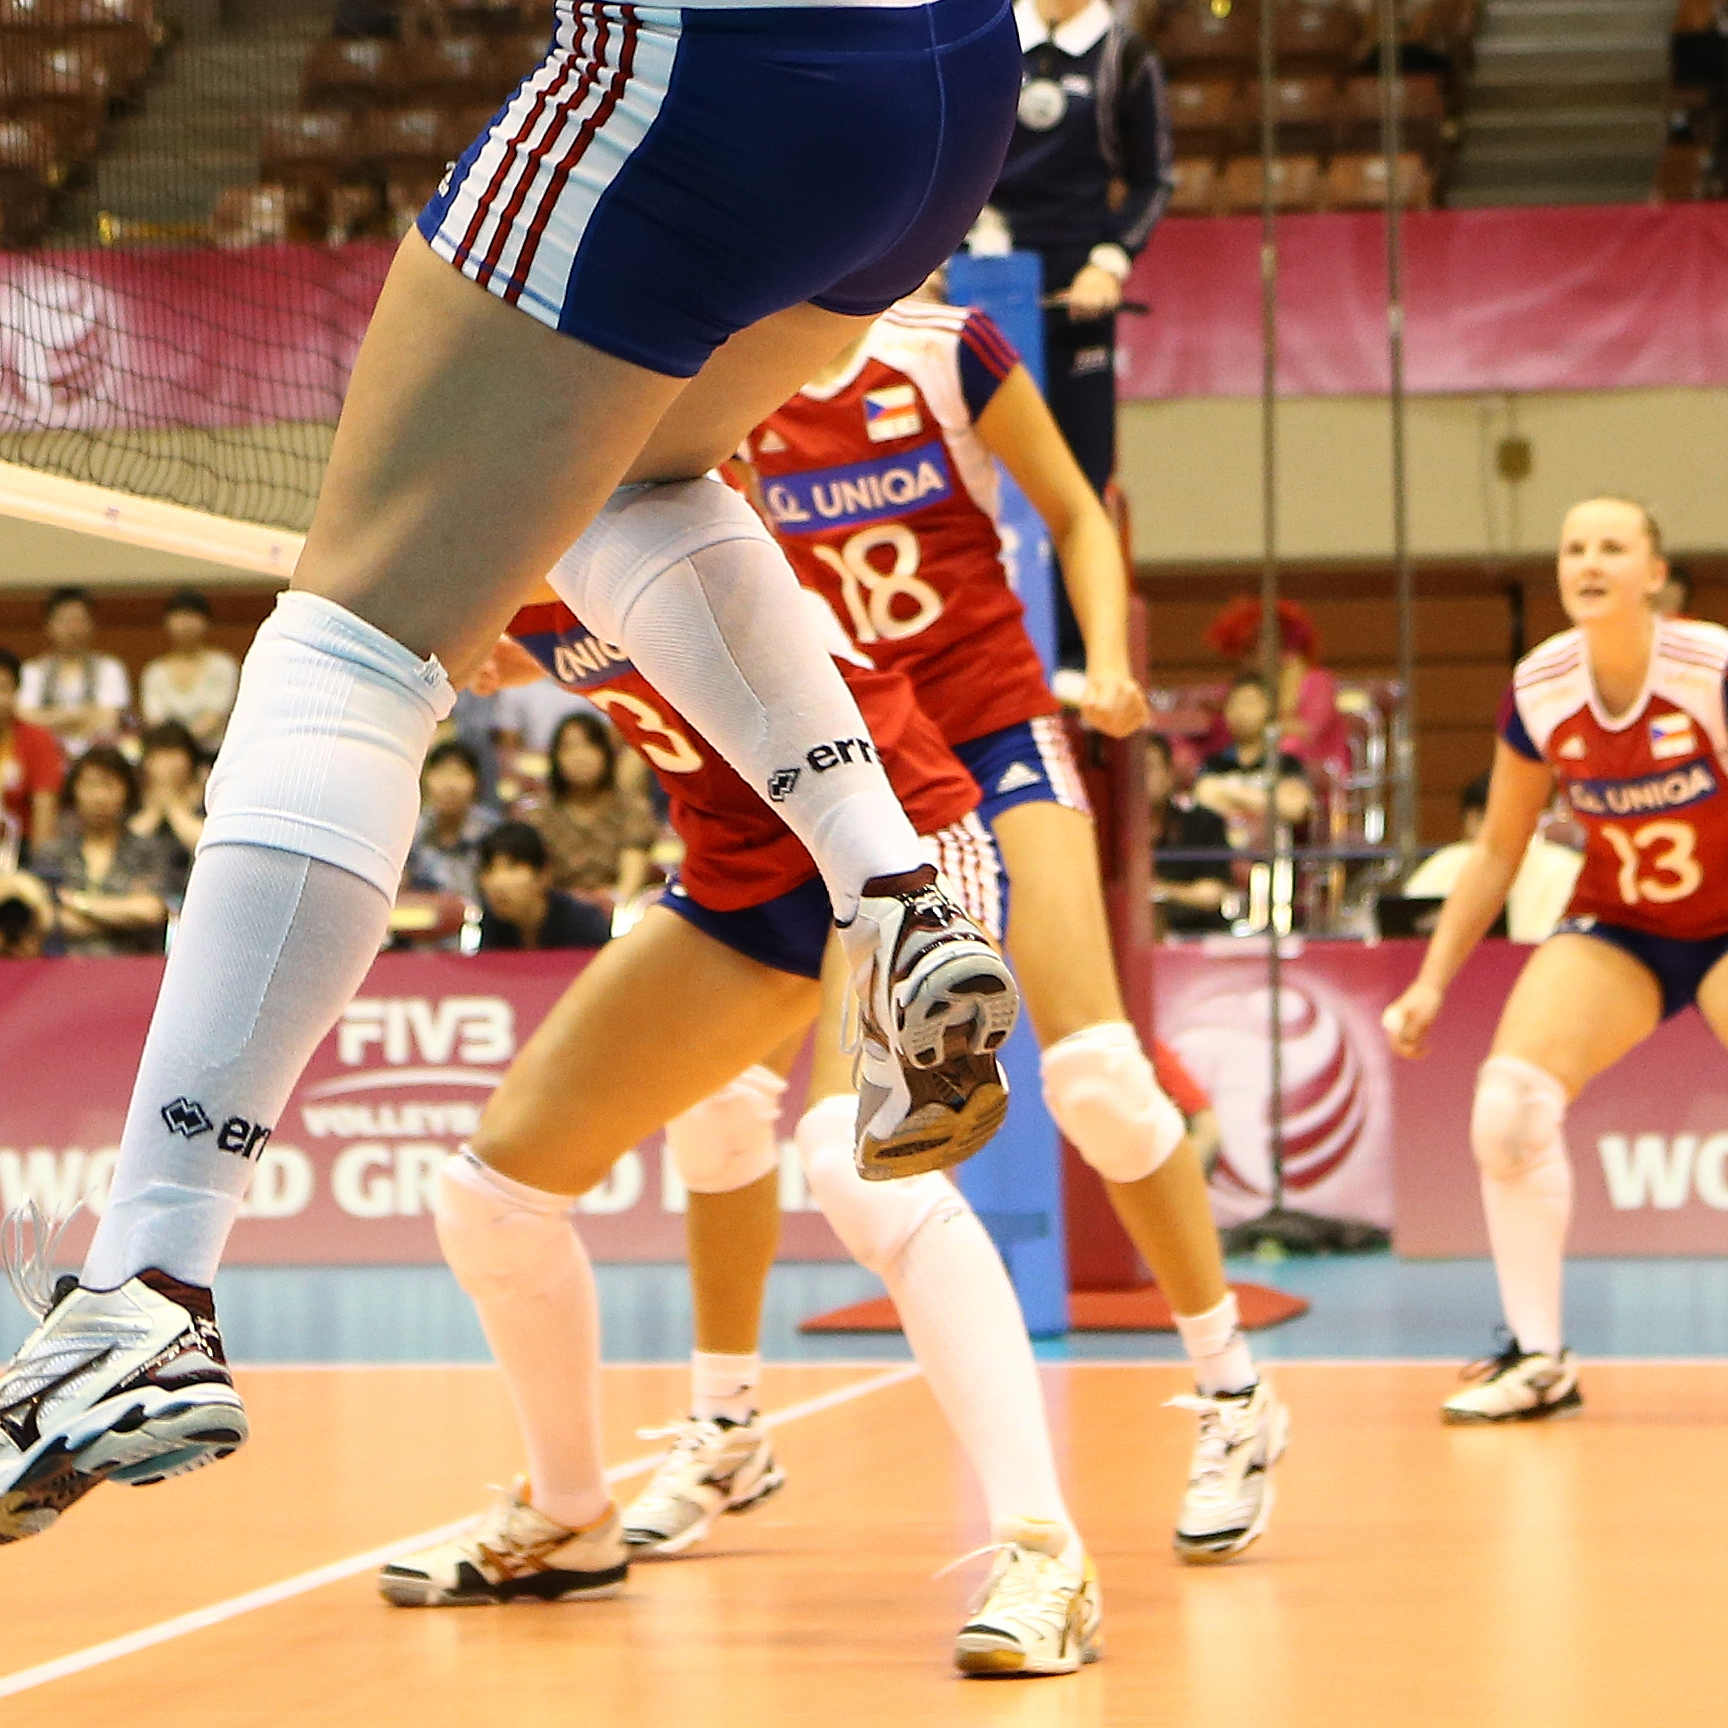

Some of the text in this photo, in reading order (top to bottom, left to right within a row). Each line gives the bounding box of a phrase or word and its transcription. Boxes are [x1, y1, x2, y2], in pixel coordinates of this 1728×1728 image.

[811, 460, 945, 519] UNIQA
[813, 522, 944, 645] 18
[1612, 763, 1718, 815] UNIQA
[1601, 820, 1704, 906] 13
[338, 998, 516, 1065] FIVB
